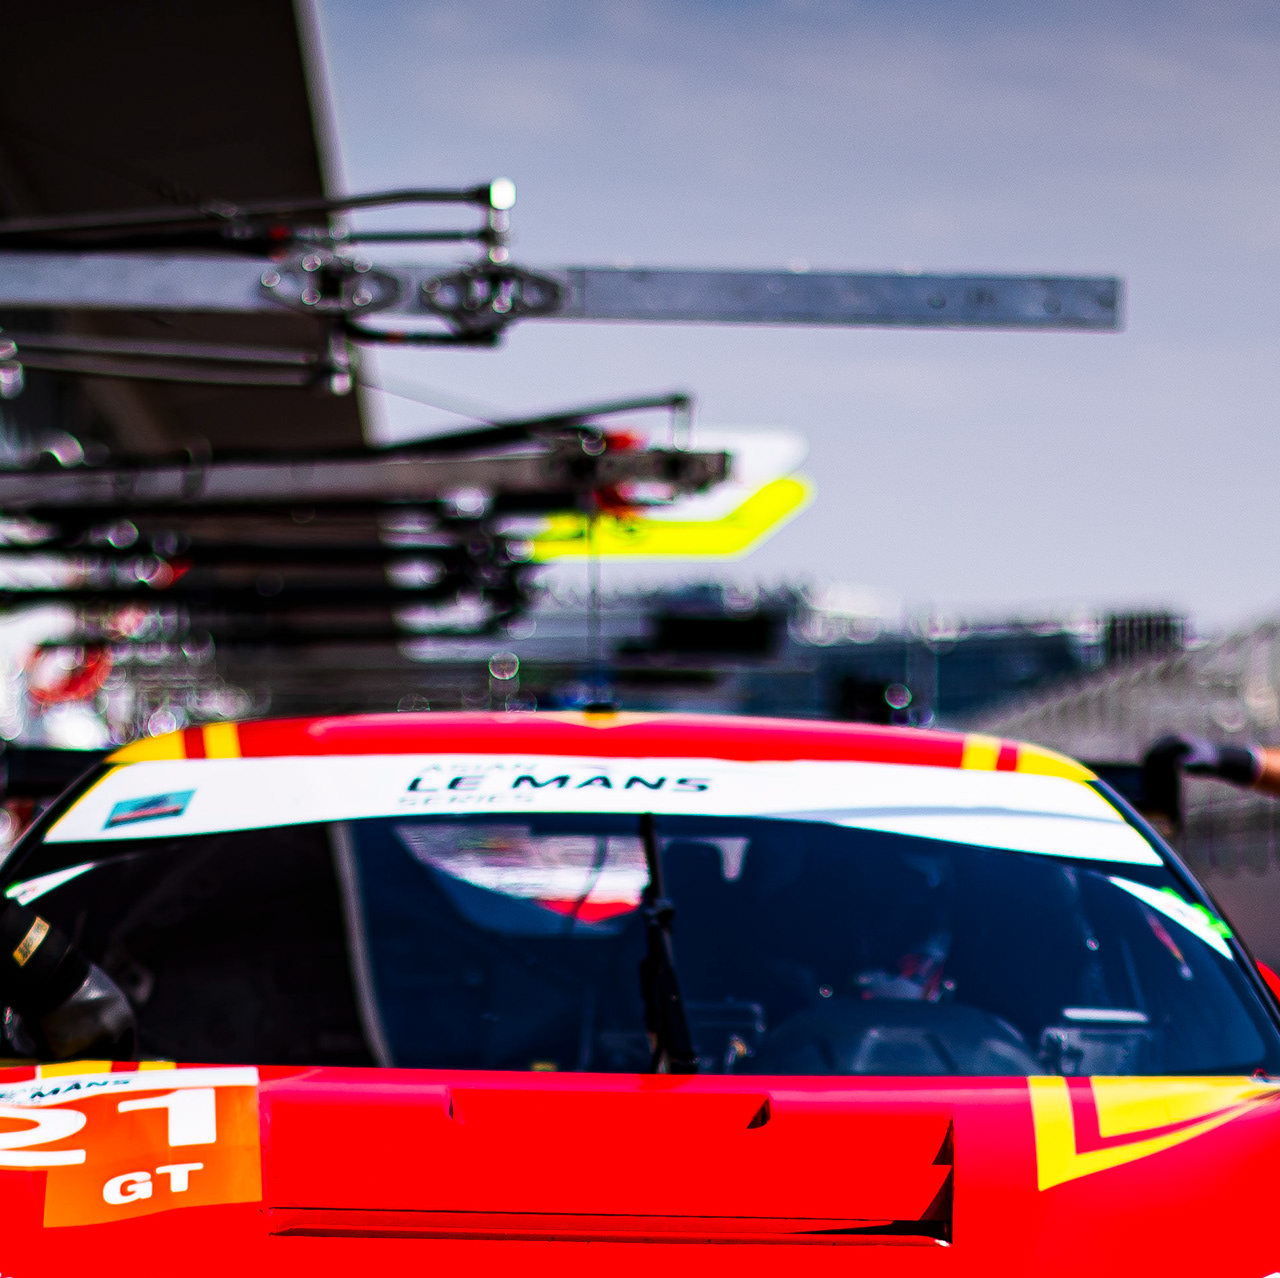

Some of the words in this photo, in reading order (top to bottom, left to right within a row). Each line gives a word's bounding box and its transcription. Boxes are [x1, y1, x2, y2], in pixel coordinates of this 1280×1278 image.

[407, 774, 487, 793] LE
[510, 774, 714, 793] MANS
[102, 1161, 204, 1205] GT
